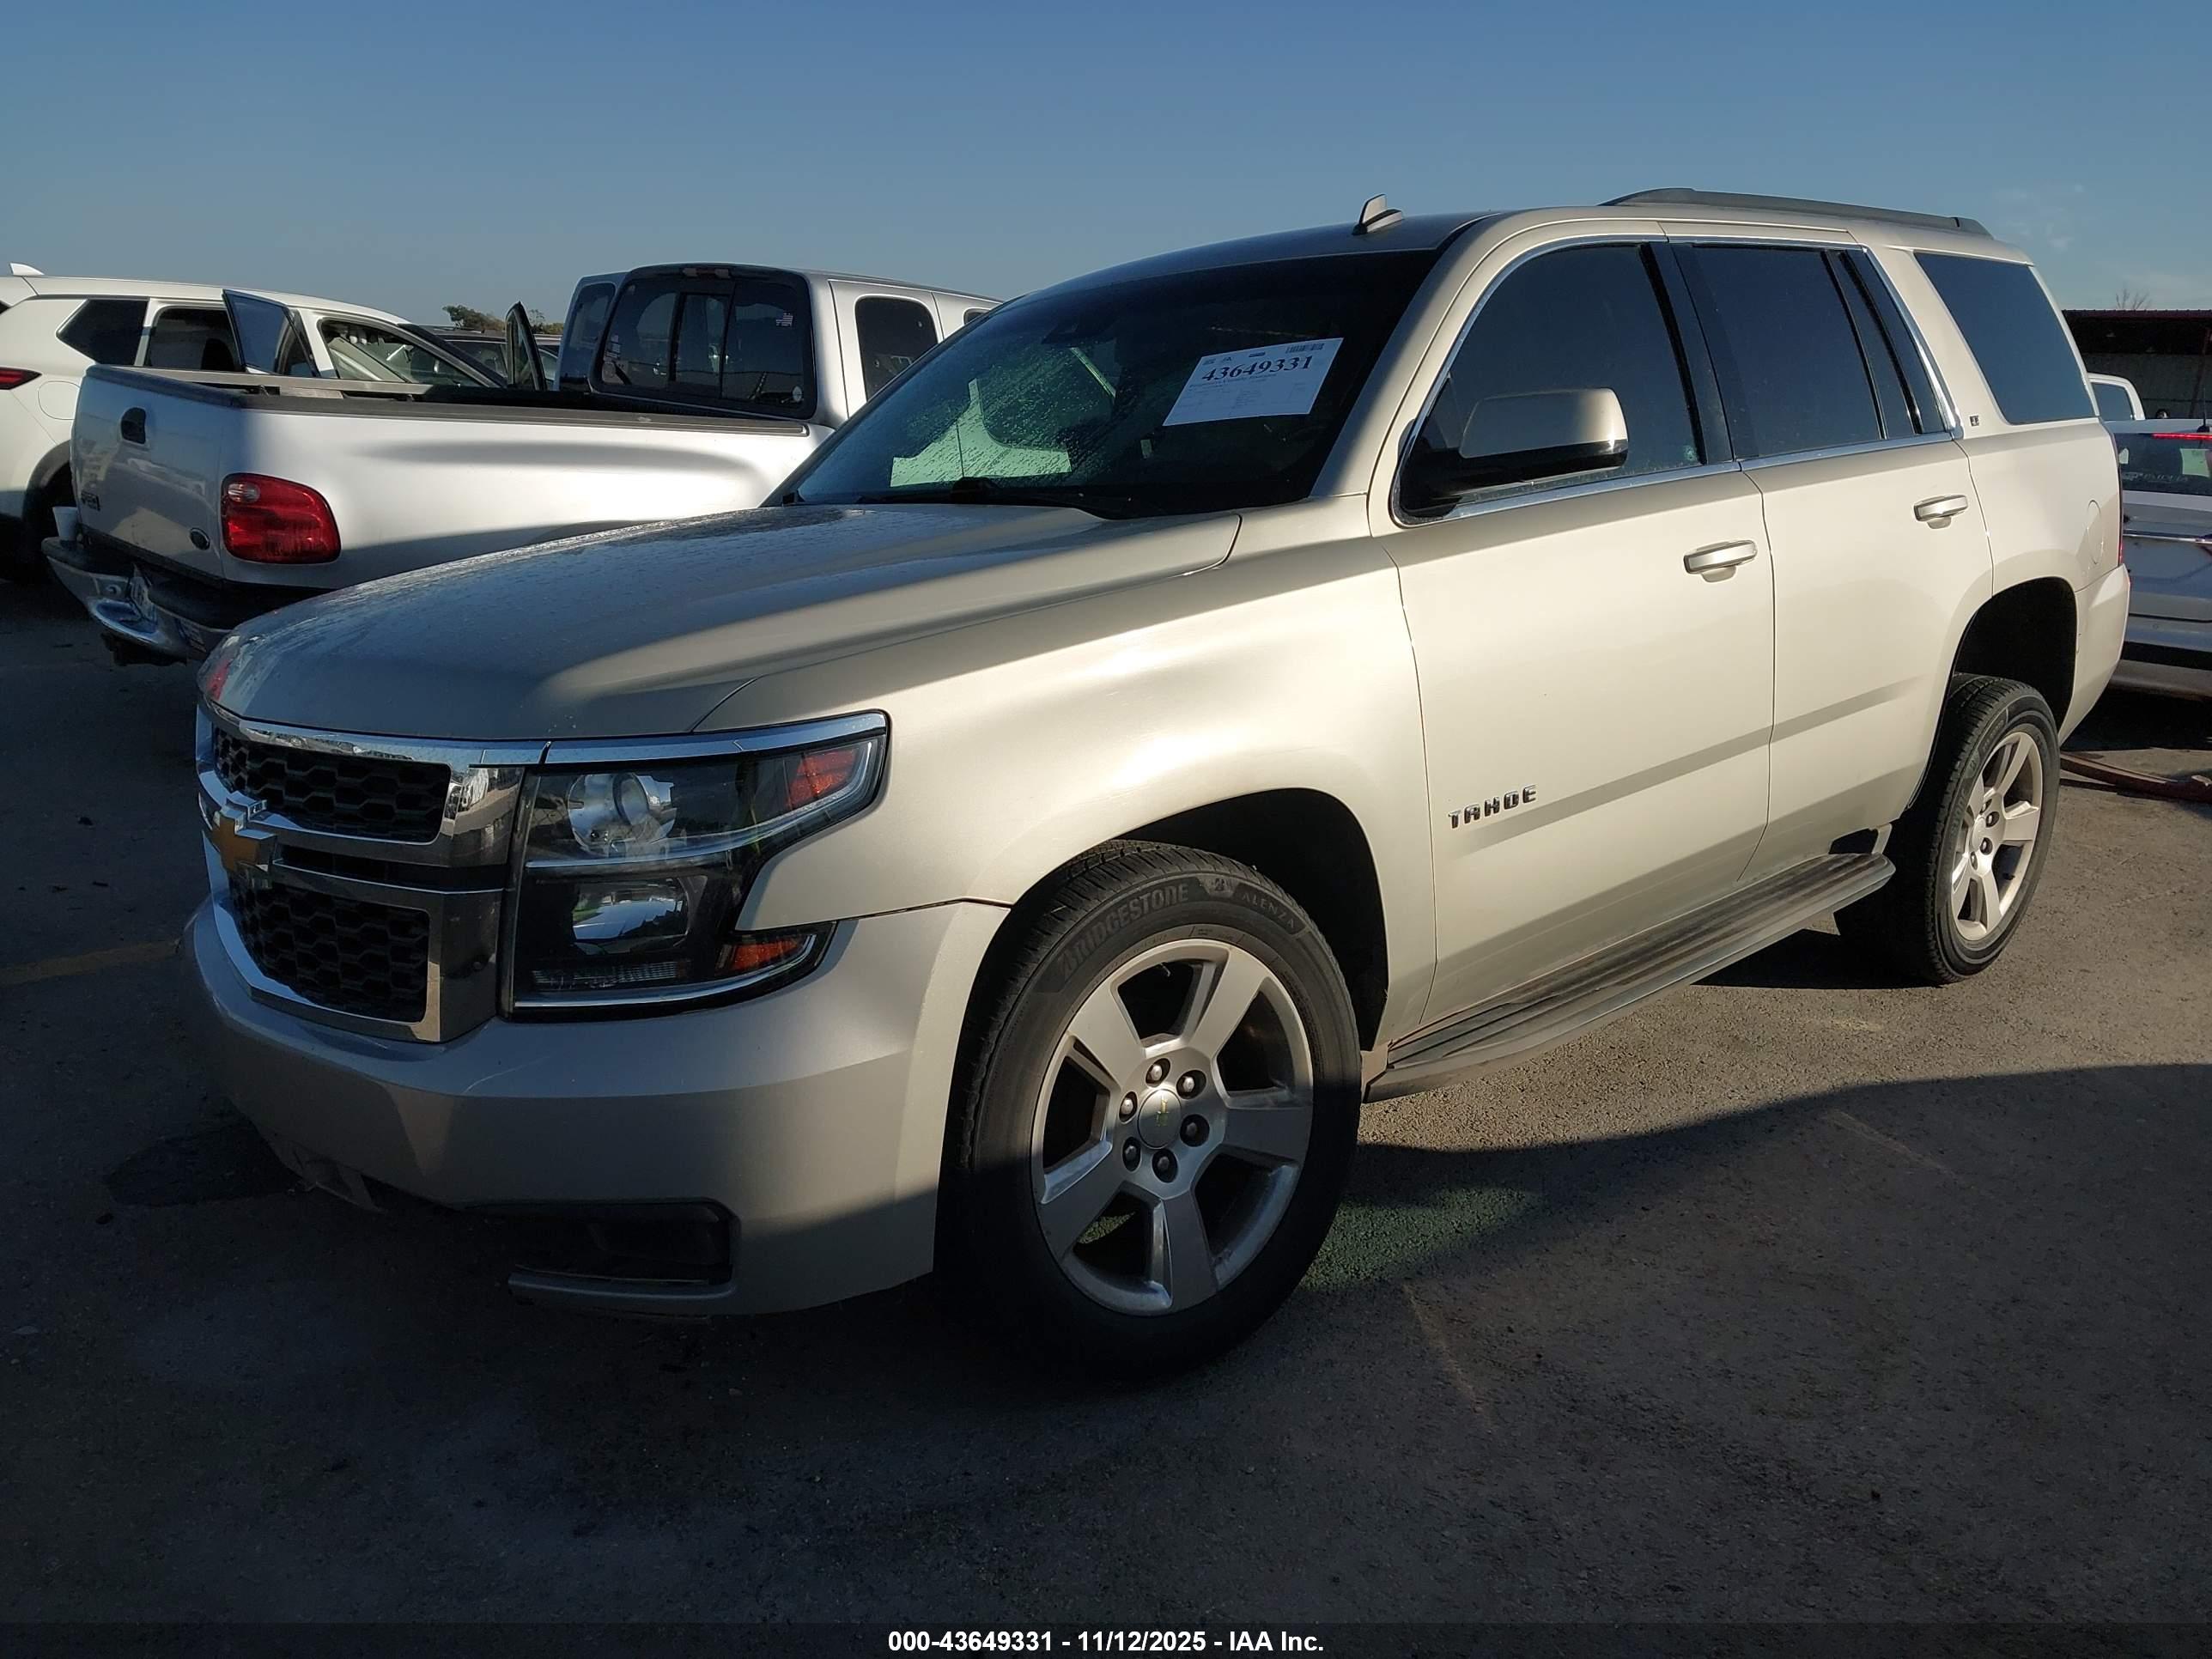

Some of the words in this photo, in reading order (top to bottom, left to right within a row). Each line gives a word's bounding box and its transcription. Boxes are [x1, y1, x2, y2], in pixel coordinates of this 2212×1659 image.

[1202, 356, 1313, 381] 43649331
[1448, 784, 1536, 829] TAHOE
[1058, 883, 1189, 977] BRIDGESTONE
[1242, 892, 1296, 929] ALENZA
